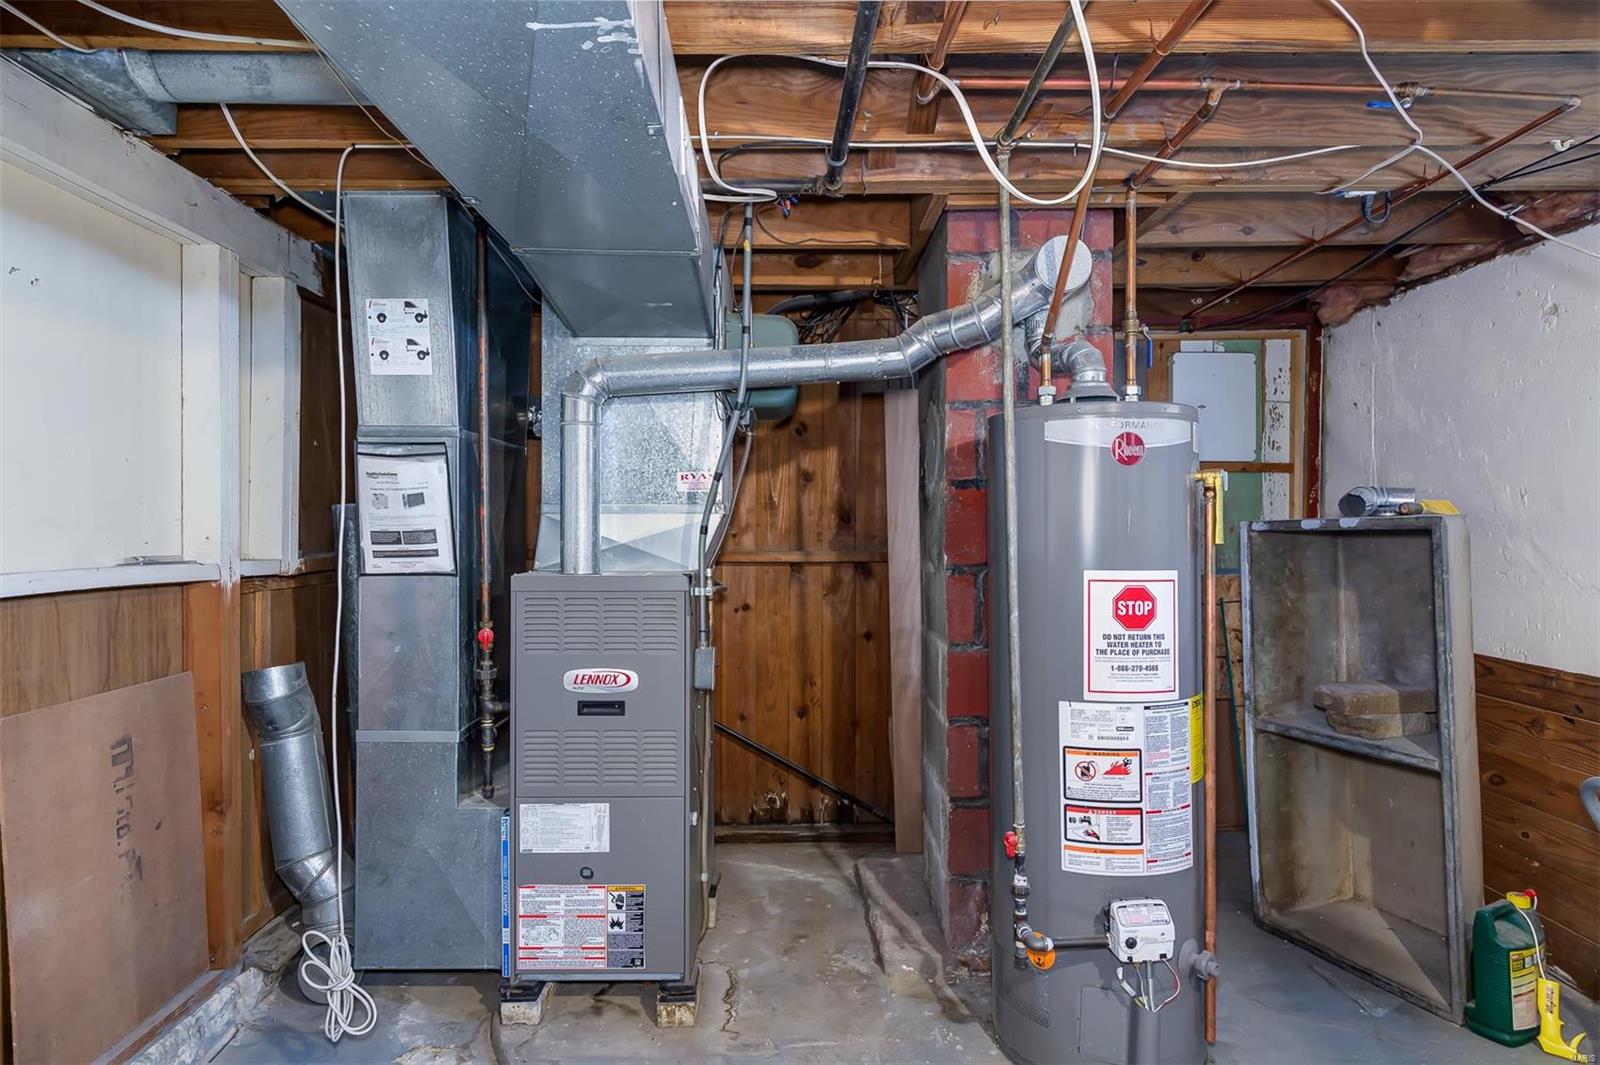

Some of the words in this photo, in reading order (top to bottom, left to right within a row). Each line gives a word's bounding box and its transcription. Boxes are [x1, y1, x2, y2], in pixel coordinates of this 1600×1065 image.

[1115, 433, 1144, 461] Rheem
[1117, 600, 1153, 616] STOP
[1153, 633, 1165, 641] THIS
[1142, 648, 1170, 656] PURCHASE
[573, 674, 620, 685] LENNOX
